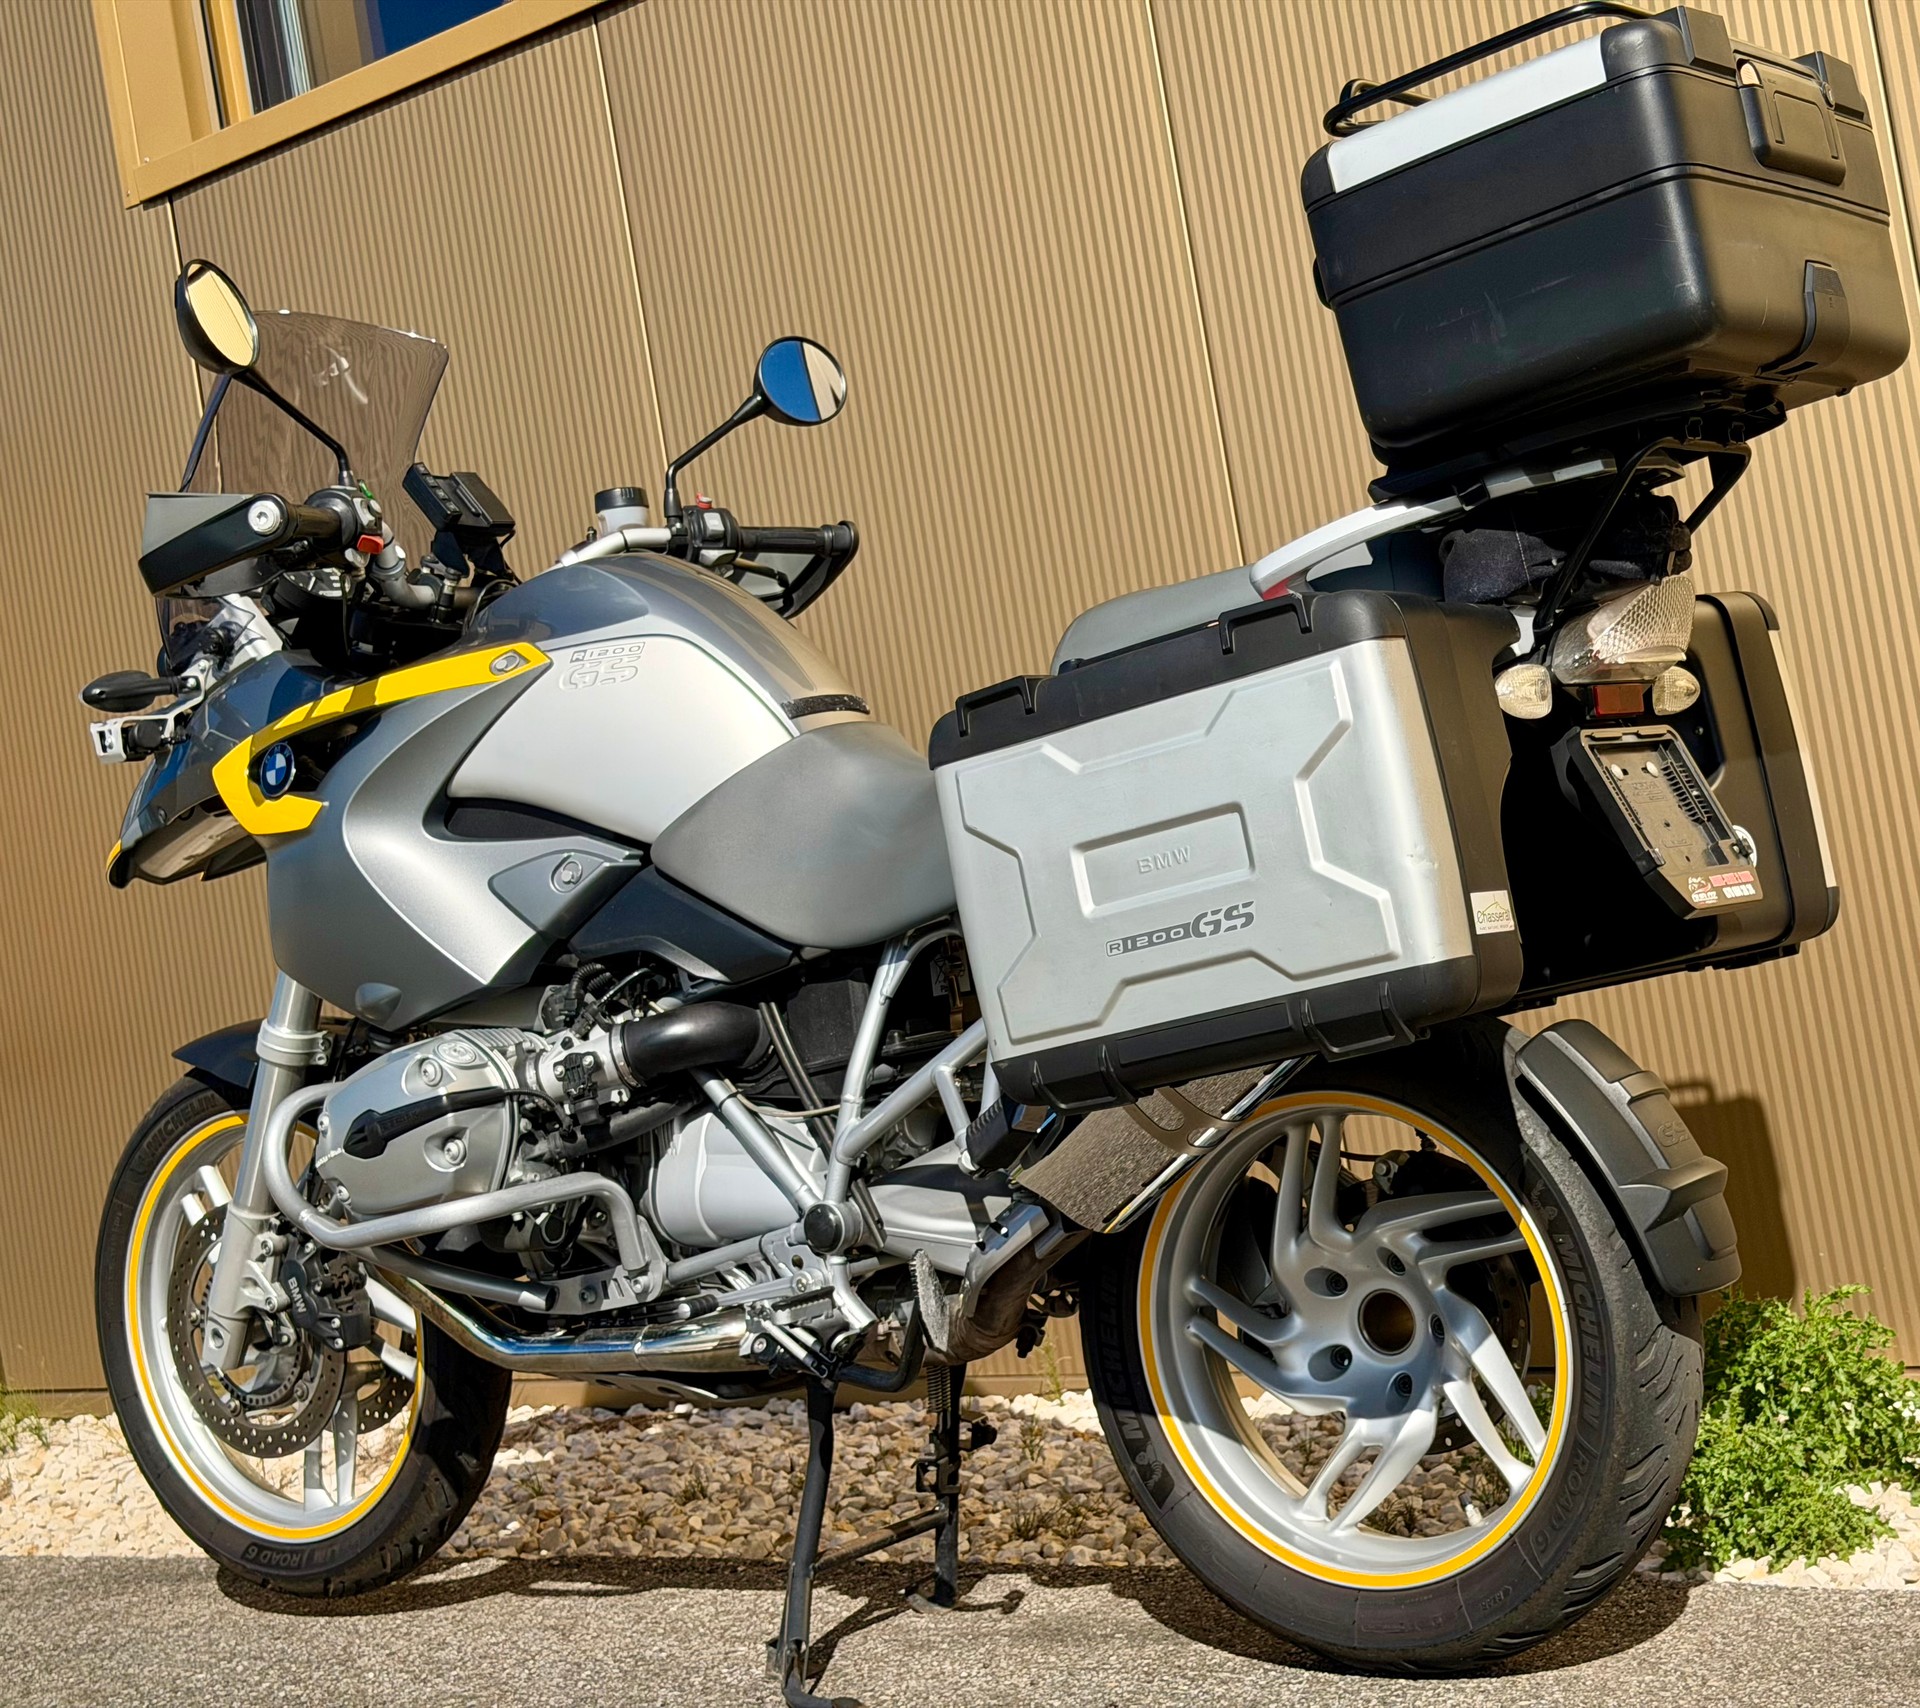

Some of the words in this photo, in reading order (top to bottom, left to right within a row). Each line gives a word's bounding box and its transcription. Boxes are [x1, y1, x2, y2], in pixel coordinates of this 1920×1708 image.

[571, 645, 642, 662] R1200
[559, 656, 641, 690] GS
[1137, 845, 1192, 874] BMW
[146, 1093, 218, 1153] MICHELIN
[287, 1276, 307, 1313] BMW
[1554, 1234, 1601, 1427] MICHELIN
[1100, 1265, 1145, 1440] MICHELIN
[1551, 1449, 1591, 1531] ROAD
[245, 1545, 259, 1559] 6
[260, 1550, 302, 1567] ROAD
[1534, 1529, 1550, 1555] 6
